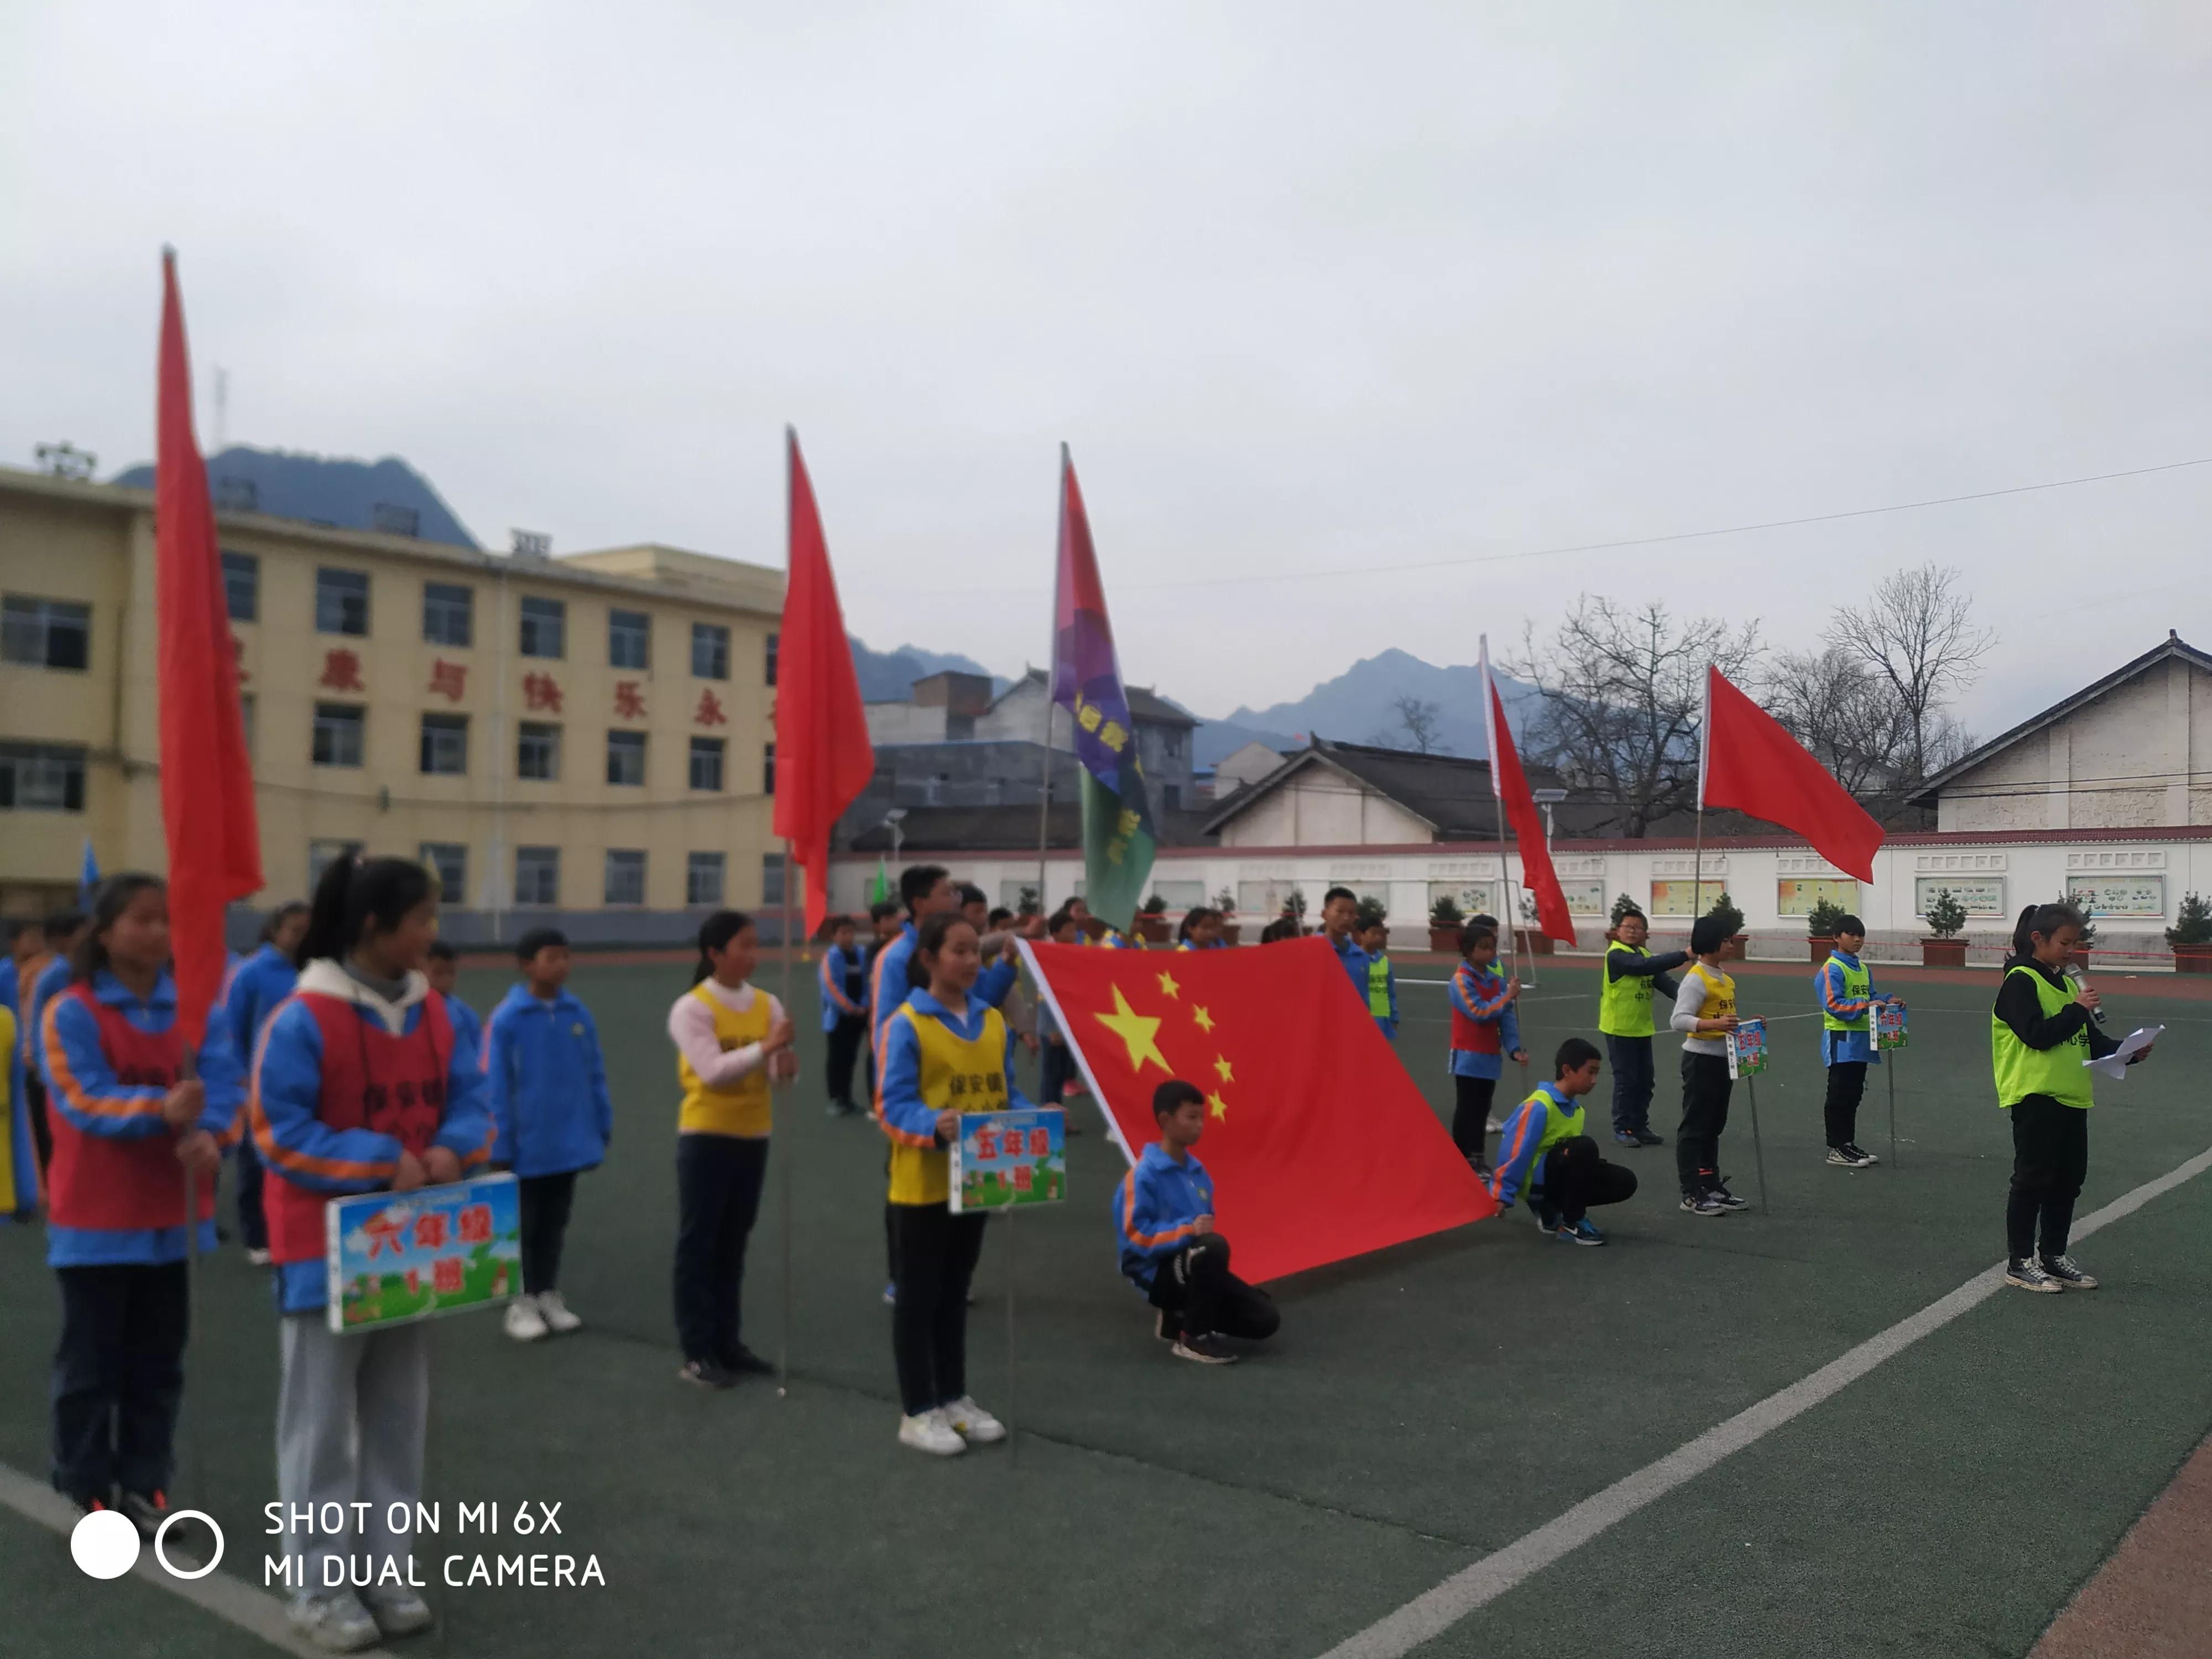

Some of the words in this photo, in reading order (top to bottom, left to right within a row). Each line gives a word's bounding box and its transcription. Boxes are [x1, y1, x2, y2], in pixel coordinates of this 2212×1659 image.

[1880, 1013, 1902, 1027] 六年级
[1738, 1030, 1761, 1051] 五年级
[977, 1127, 1048, 1160] 五年级
[997, 1165, 1032, 1191] 1班
[364, 1204, 492, 1260] 六年级
[404, 1257, 465, 1295] 1班
